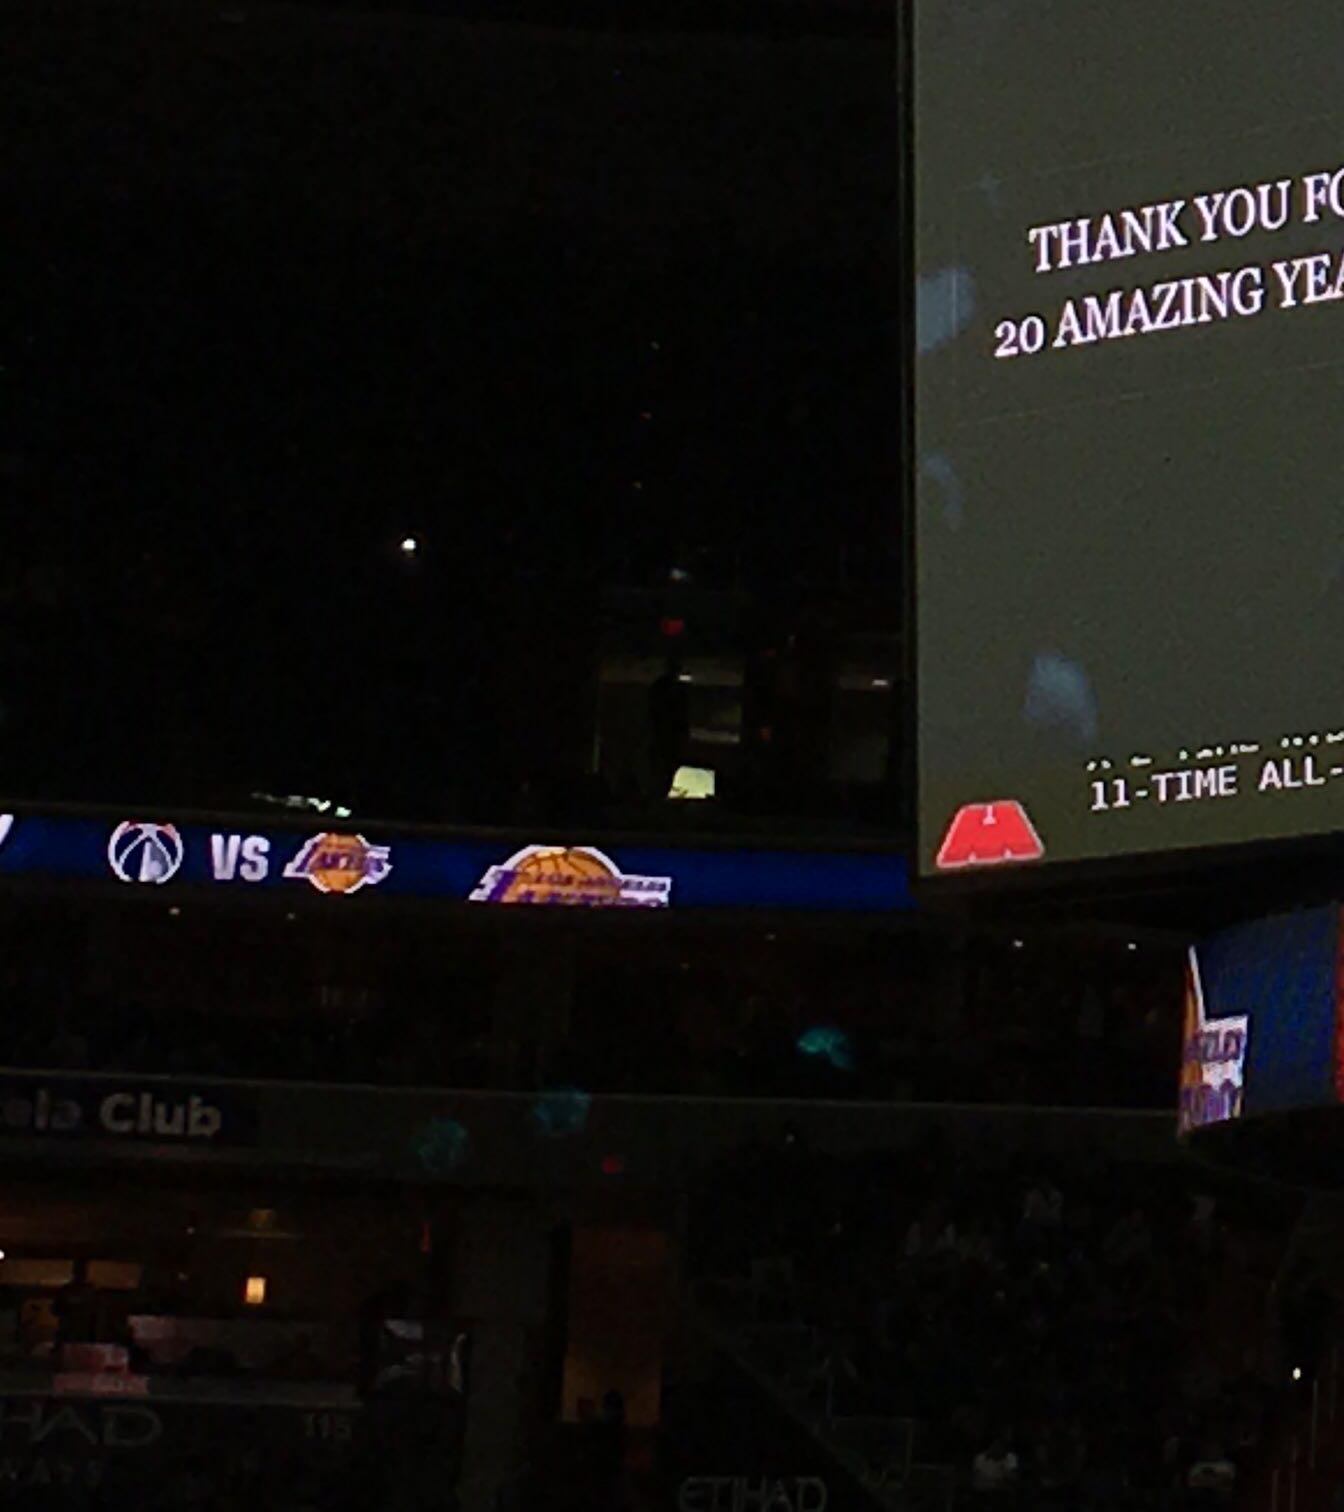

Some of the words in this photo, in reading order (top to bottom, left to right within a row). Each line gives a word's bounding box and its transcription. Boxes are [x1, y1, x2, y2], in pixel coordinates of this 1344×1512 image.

[1028, 201, 1187, 272] THANK
[1195, 180, 1290, 242] YOU
[994, 315, 1044, 358] 20
[1053, 268, 1264, 349] AMAZING
[1090, 765, 1237, 811] 11-TIME
[211, 834, 269, 881] VS
[100, 1092, 221, 1136] Club
